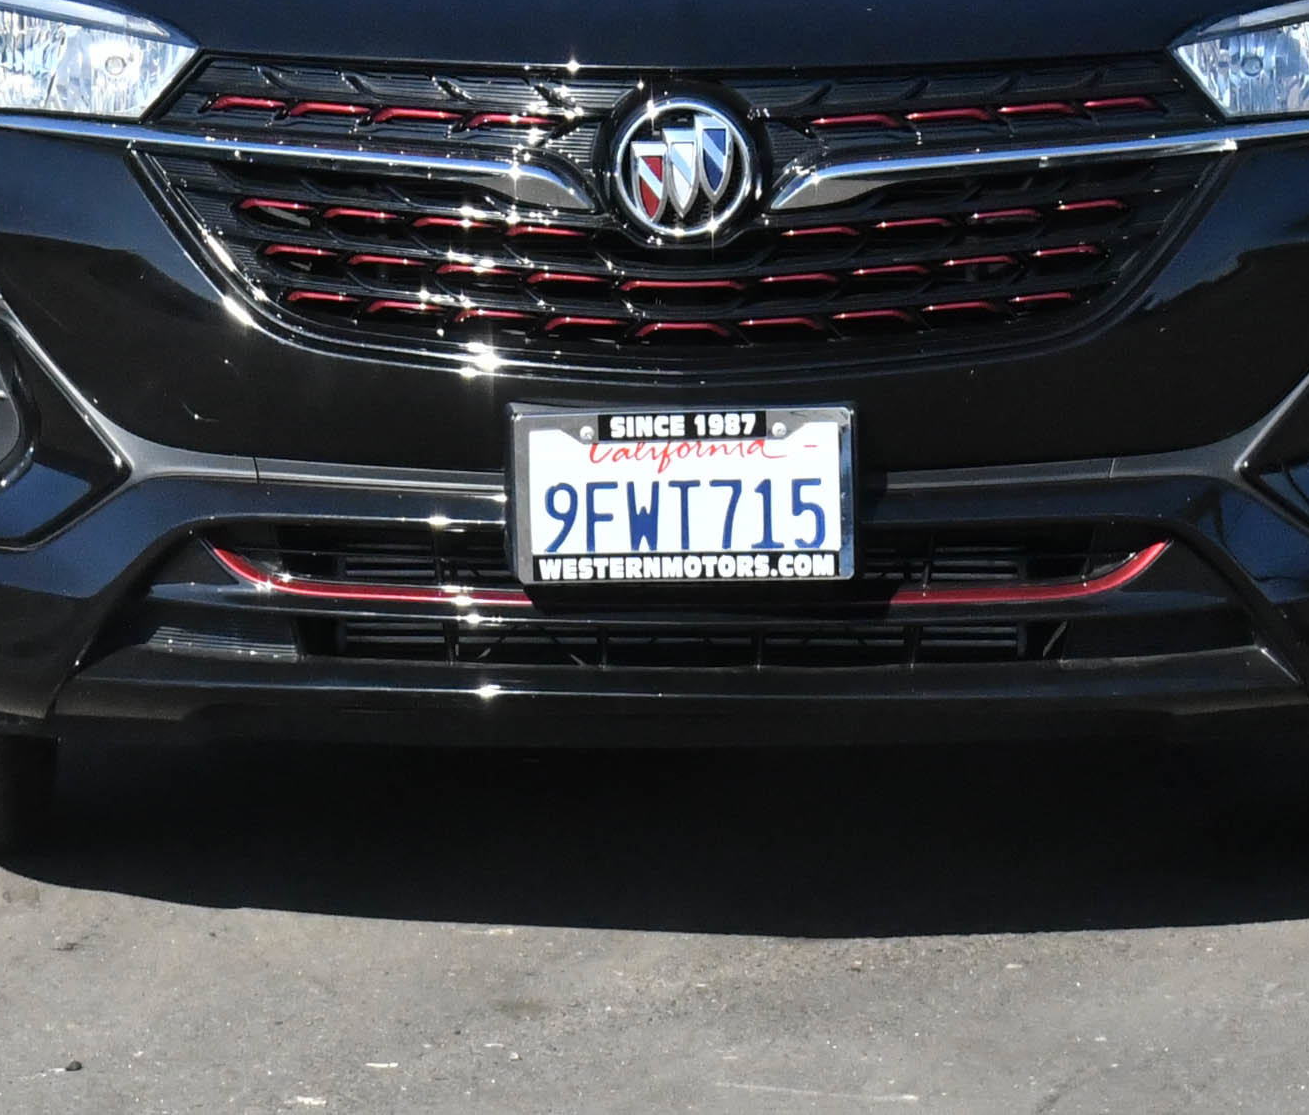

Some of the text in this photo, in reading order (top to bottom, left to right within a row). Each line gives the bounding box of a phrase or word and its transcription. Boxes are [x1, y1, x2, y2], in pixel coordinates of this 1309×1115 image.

[609, 412, 757, 439] SINCE 1987
[544, 478, 826, 553] 9FWT715
[538, 553, 836, 581] WESTERNMOTORS.COM
